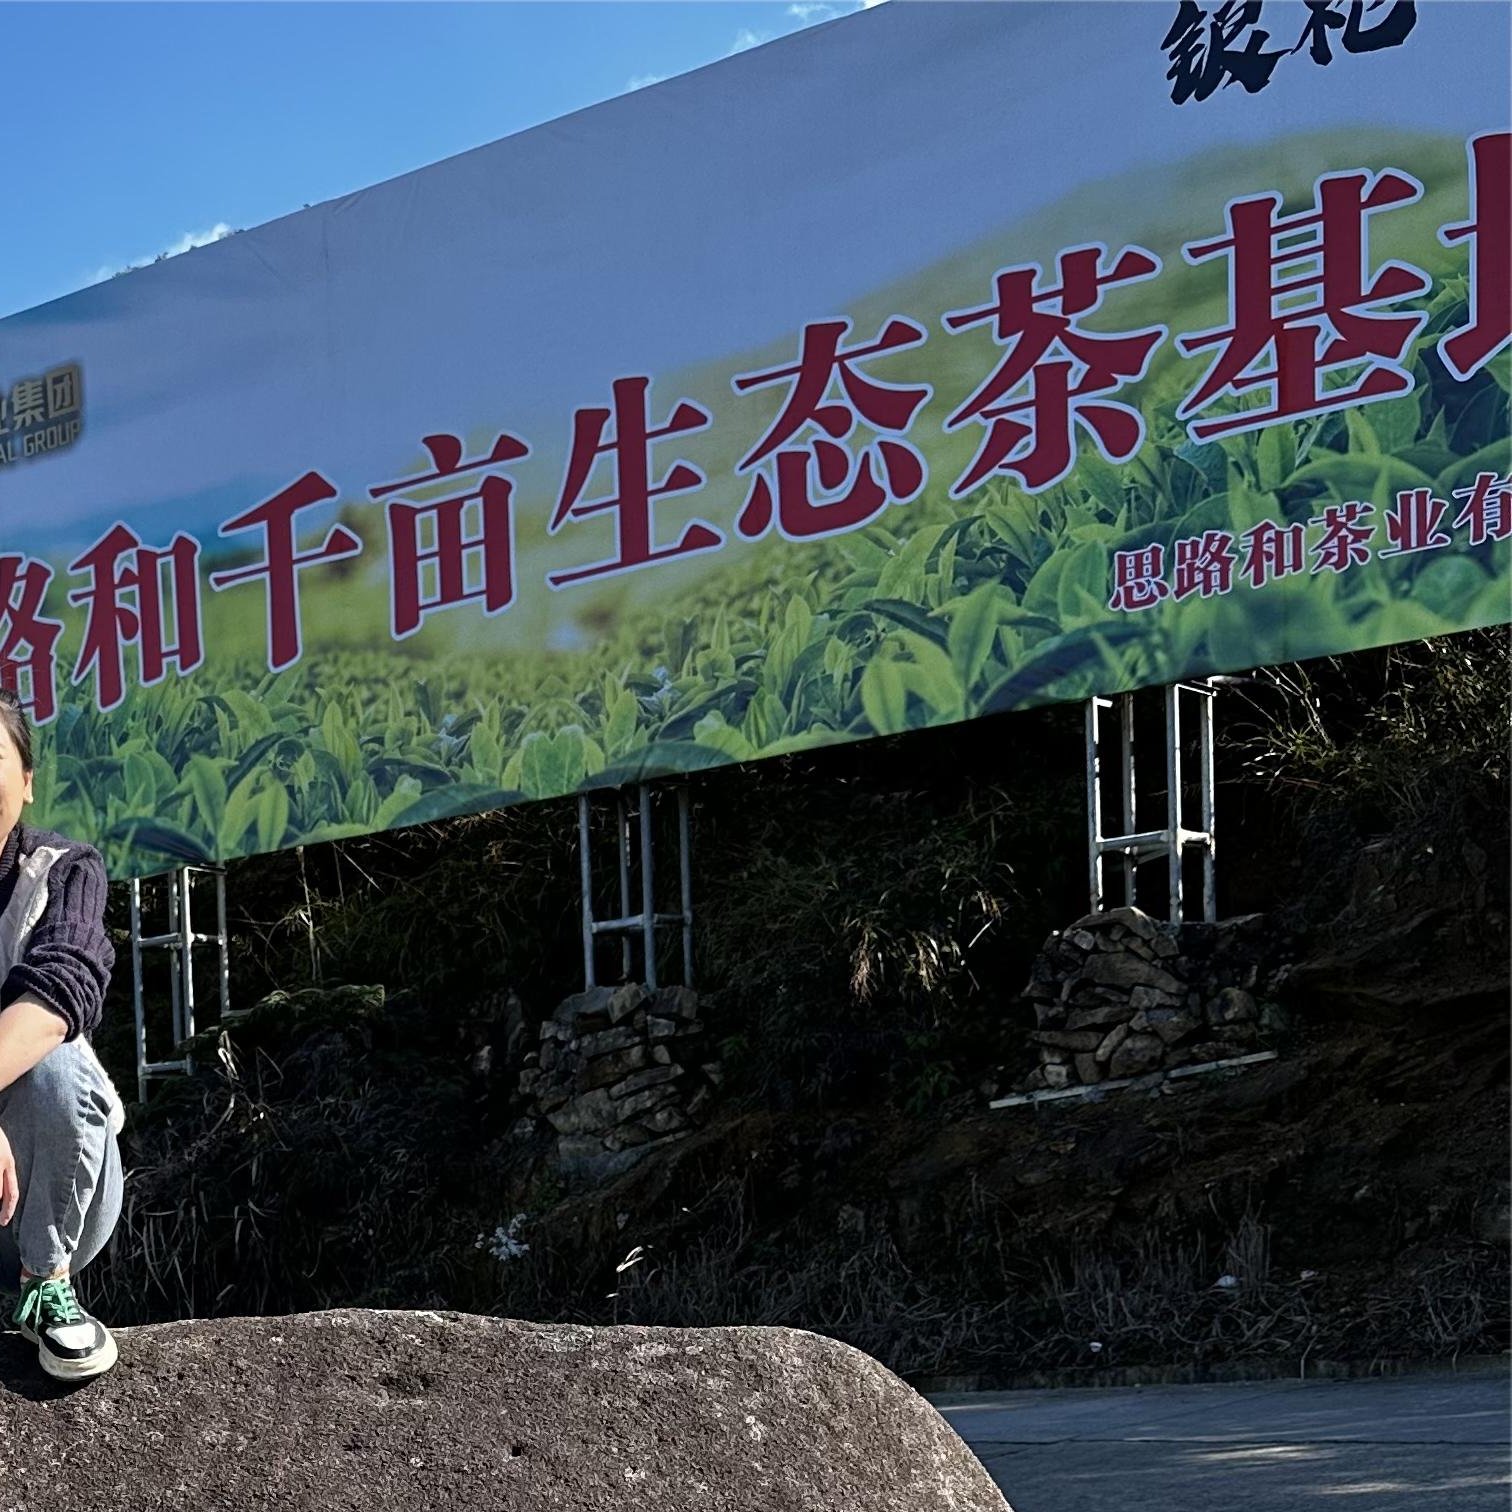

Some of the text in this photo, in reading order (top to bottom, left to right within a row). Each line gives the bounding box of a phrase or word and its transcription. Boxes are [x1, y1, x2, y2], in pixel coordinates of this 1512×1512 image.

[23, 418, 82, 458] GROUP
[1109, 472, 1512, 612] 思路和茶业有
